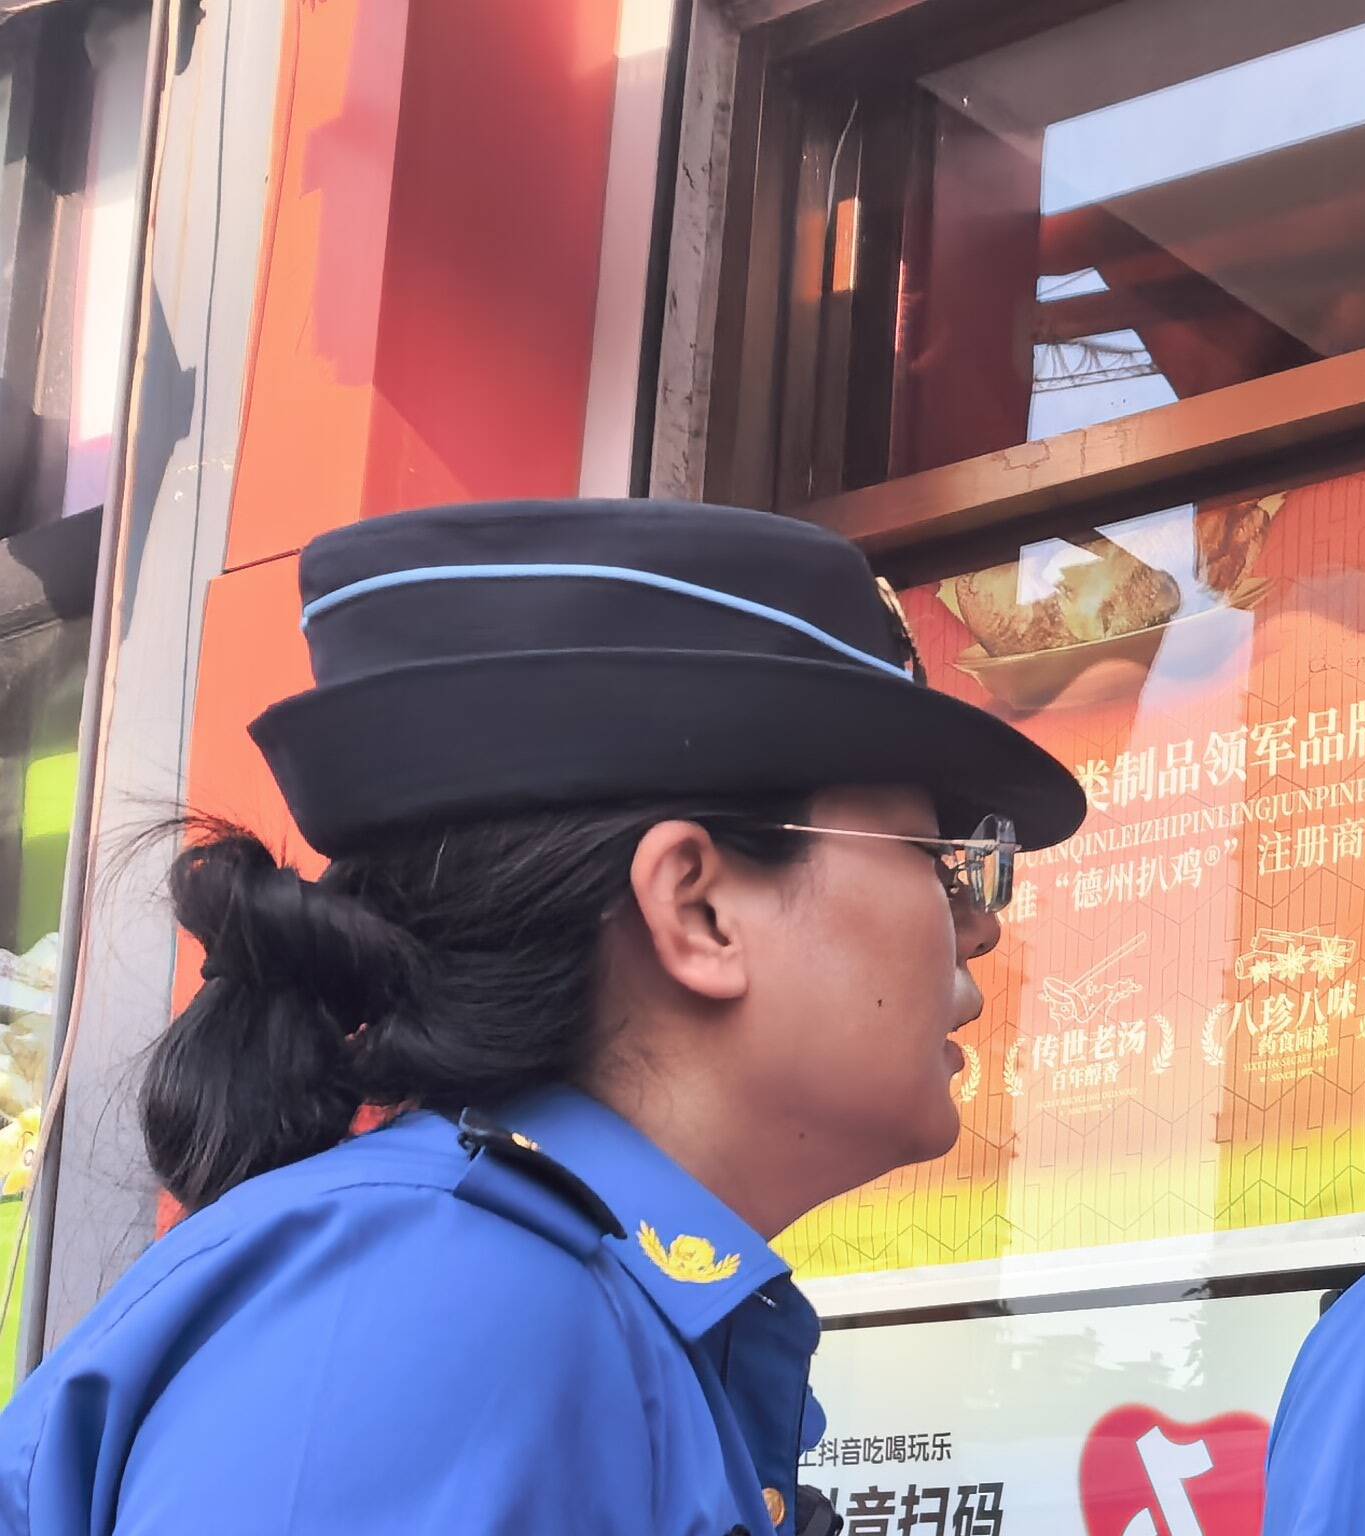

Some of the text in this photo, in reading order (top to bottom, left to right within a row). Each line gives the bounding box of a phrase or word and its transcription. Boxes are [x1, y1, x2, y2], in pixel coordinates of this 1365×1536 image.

[1226, 980, 1357, 1041] 八珍八味
[1032, 1019, 1147, 1071] 传世老汤
[1258, 1023, 1329, 1057] 药食同源
